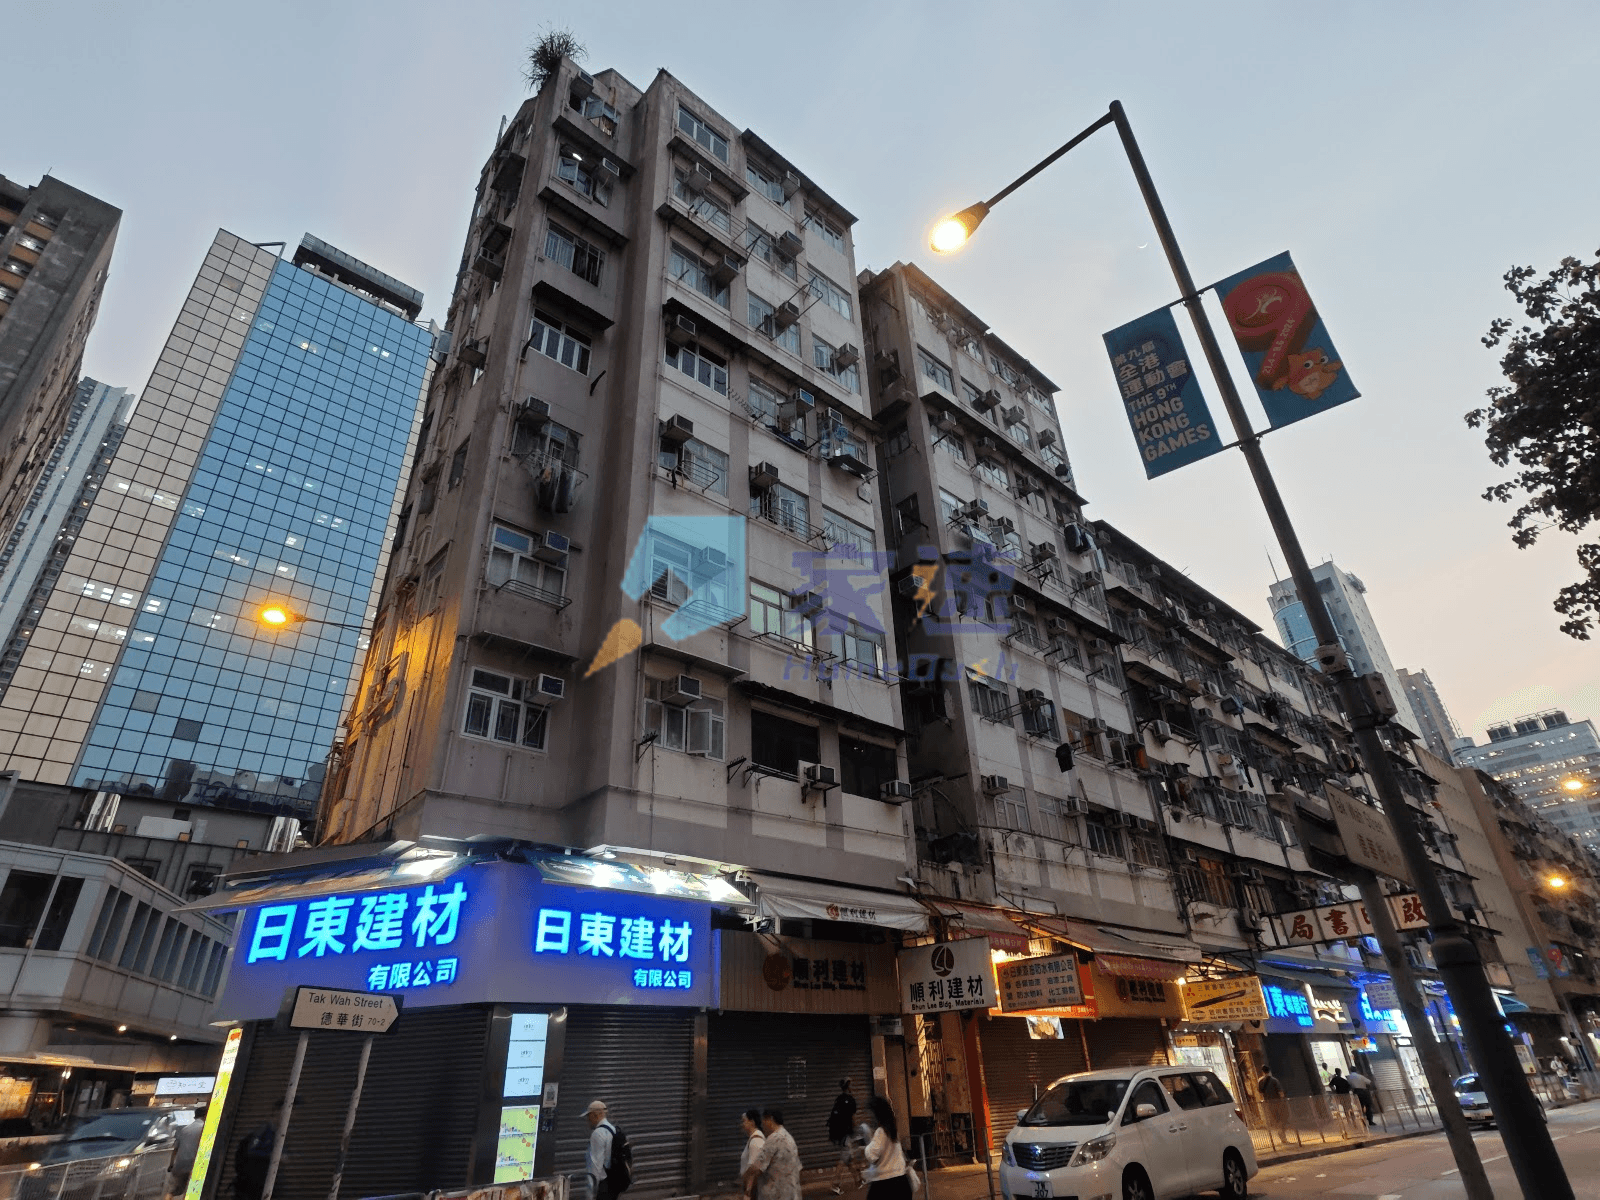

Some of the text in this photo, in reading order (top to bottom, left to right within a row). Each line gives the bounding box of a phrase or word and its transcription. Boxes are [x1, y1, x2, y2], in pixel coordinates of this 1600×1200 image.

[1114, 340, 1156, 366] 第九屆
[1119, 352, 1160, 382] 全港
[1123, 359, 1188, 398] 運動會
[1128, 382, 1177, 412] THE 9TH
[1133, 396, 1184, 429] HONG
[1139, 412, 1190, 445] KONG
[1145, 423, 1211, 461] GAMES
[248, 882, 467, 963] 日東建材
[536, 908, 692, 962] 日東建材
[368, 958, 458, 990] 有限公司
[634, 968, 692, 989] 有限公司
[910, 975, 983, 1002] 順利建材
[308, 992, 383, 1009] Tak Wah Street
[955, 998, 985, 1007] Materials
[321, 1012, 386, 1027] 德華街 70-2
[1035, 1189, 1049, 1198] 307
